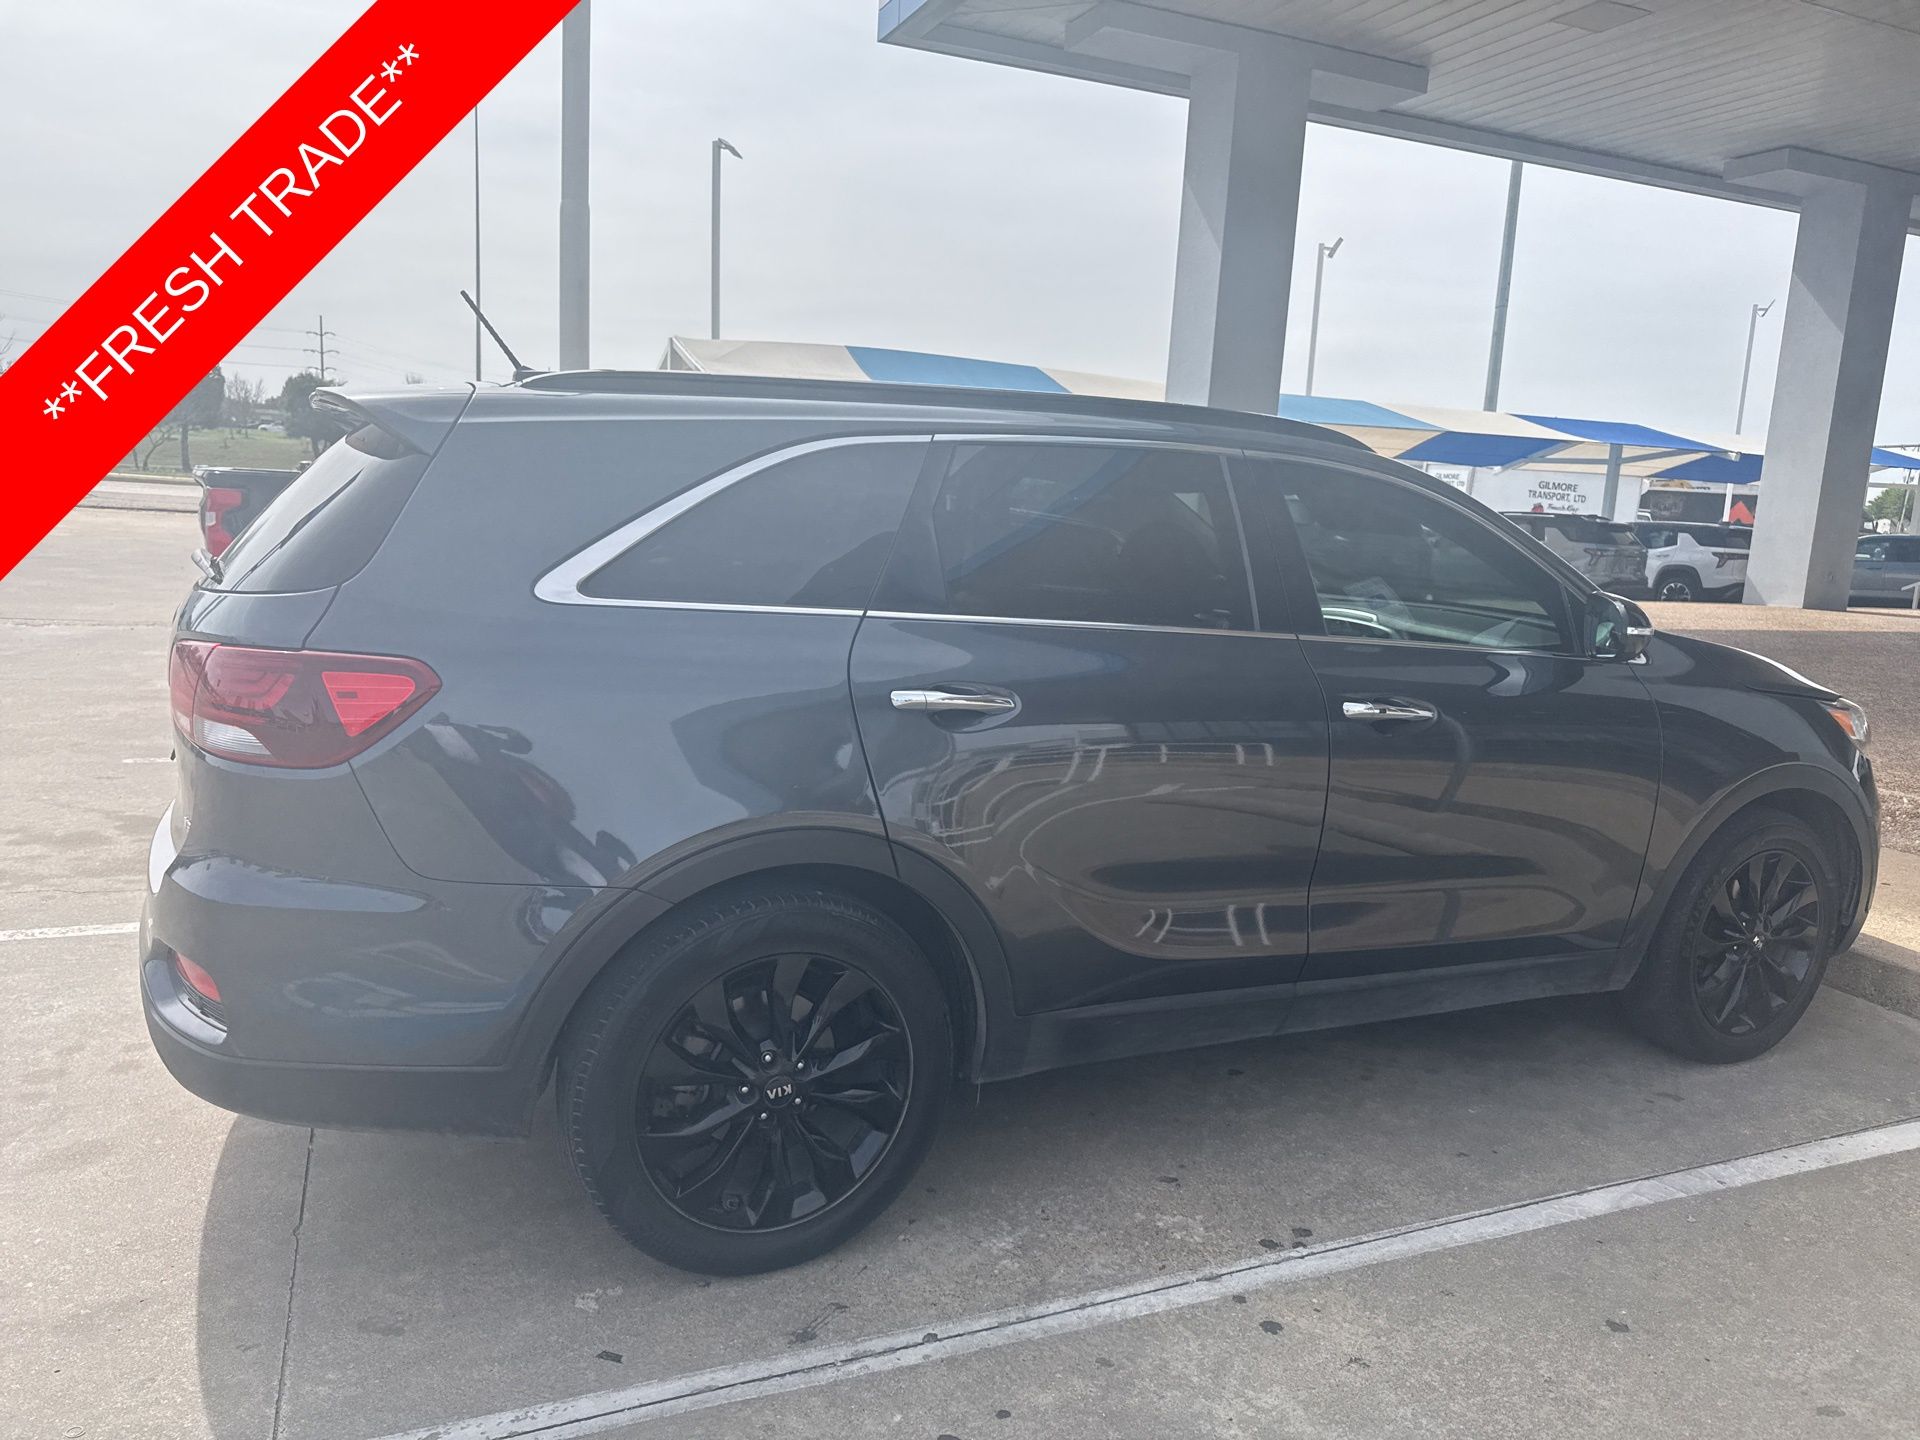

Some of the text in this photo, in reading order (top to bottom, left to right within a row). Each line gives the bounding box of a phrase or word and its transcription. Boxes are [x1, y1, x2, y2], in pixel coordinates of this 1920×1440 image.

[1538, 480, 1579, 492] GILMORE
[1573, 494, 1587, 503] LTD
[766, 1083, 792, 1100] KIA
